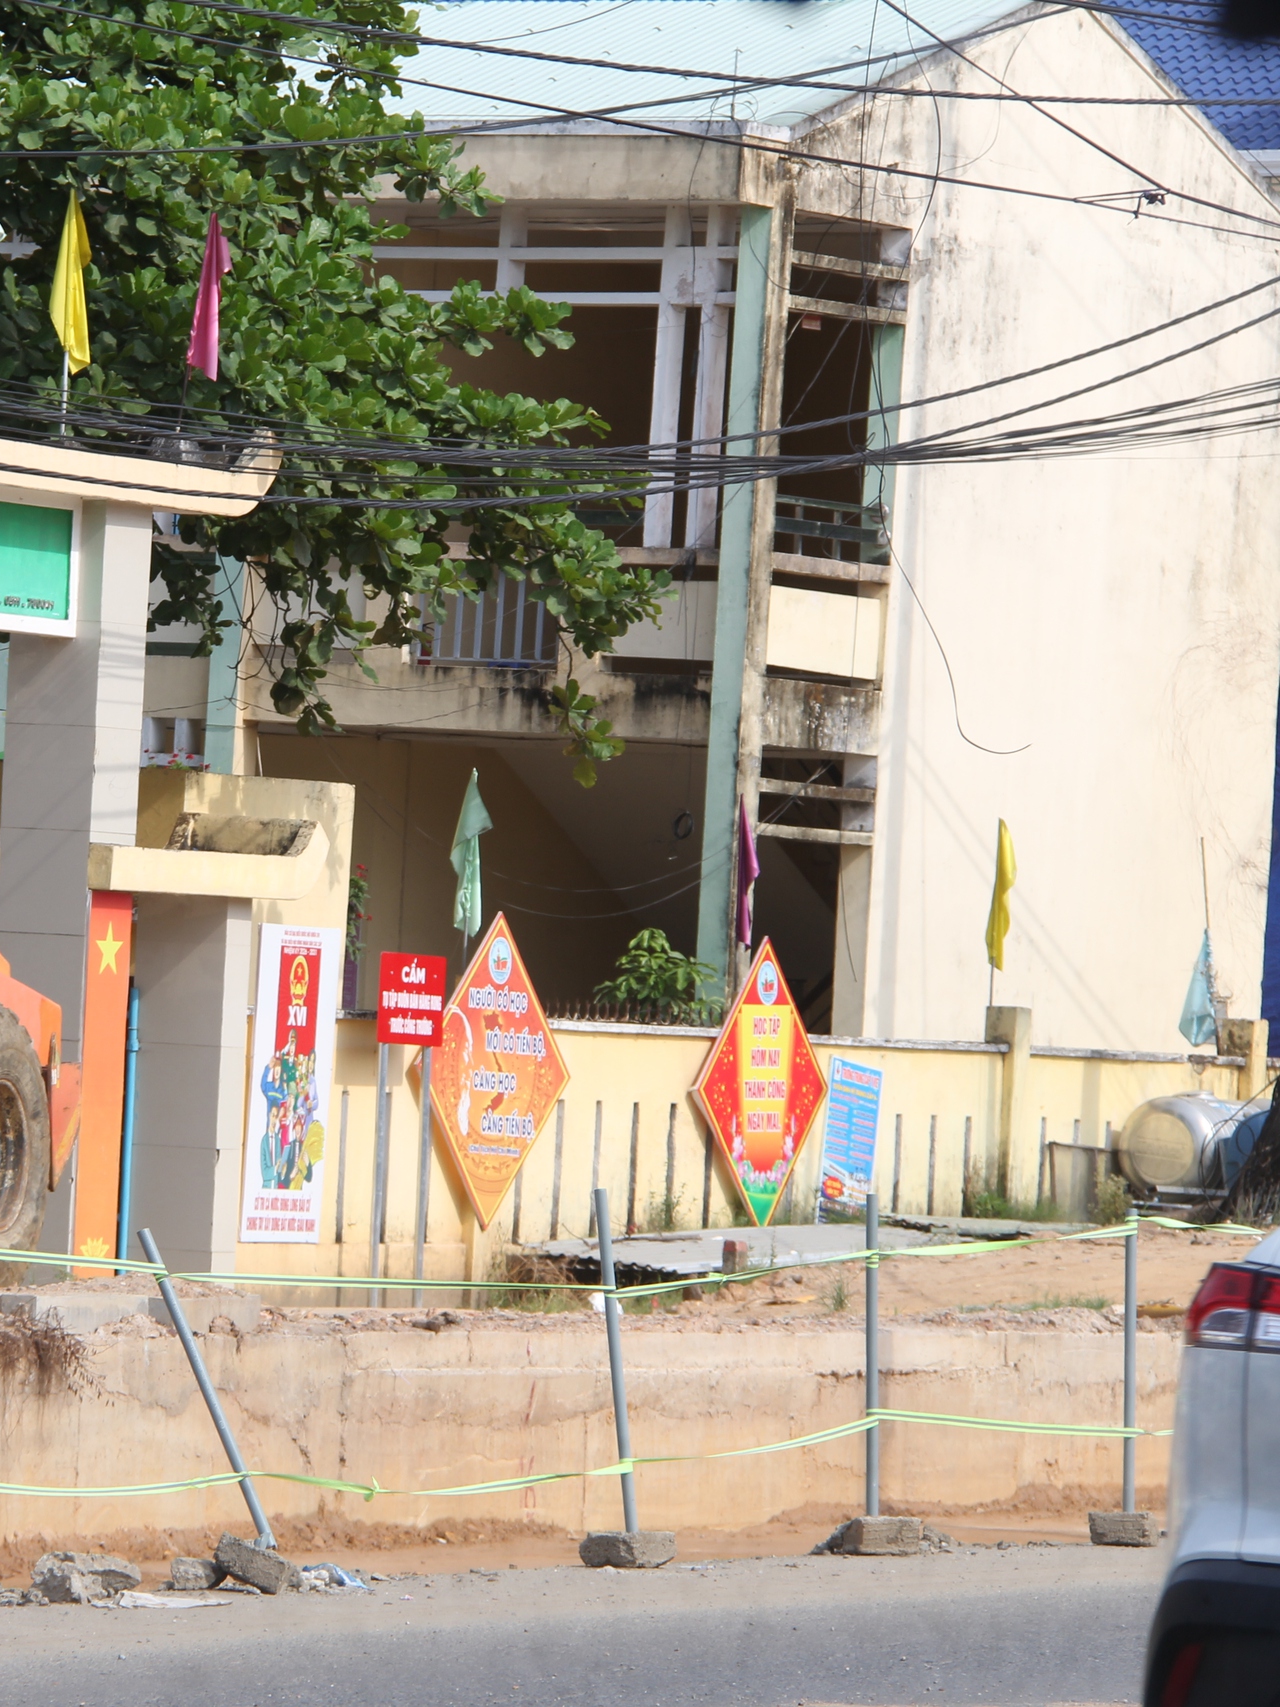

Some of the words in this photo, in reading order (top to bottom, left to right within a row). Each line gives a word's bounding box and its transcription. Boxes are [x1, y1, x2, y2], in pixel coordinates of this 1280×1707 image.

[401, 957, 426, 984] CẤM
[468, 983, 496, 1009] NGƯỜI
[497, 985, 509, 1011] CÓ
[509, 991, 528, 1018] HỌC
[287, 1005, 307, 1027] XVI
[753, 1017, 767, 1040] HỌC
[768, 1013, 780, 1040] TẬP
[486, 1026, 501, 1052] MỚI
[502, 1028, 514, 1053] CÓ
[516, 1026, 531, 1055] TIẾN
[532, 1031, 546, 1061] BỘ.
[751, 1045, 766, 1067] HÔM
[767, 1048, 780, 1067] NAY
[473, 1065, 496, 1091] CÀNG
[498, 1072, 516, 1098] HỌC
[745, 1077, 766, 1099] THÀNH
[767, 1077, 786, 1099] CÔNG
[481, 1108, 503, 1135] CÀNG
[505, 1108, 520, 1137] TIẾN
[521, 1112, 535, 1143] BỘ.
[747, 1108, 765, 1131] NGÀY
